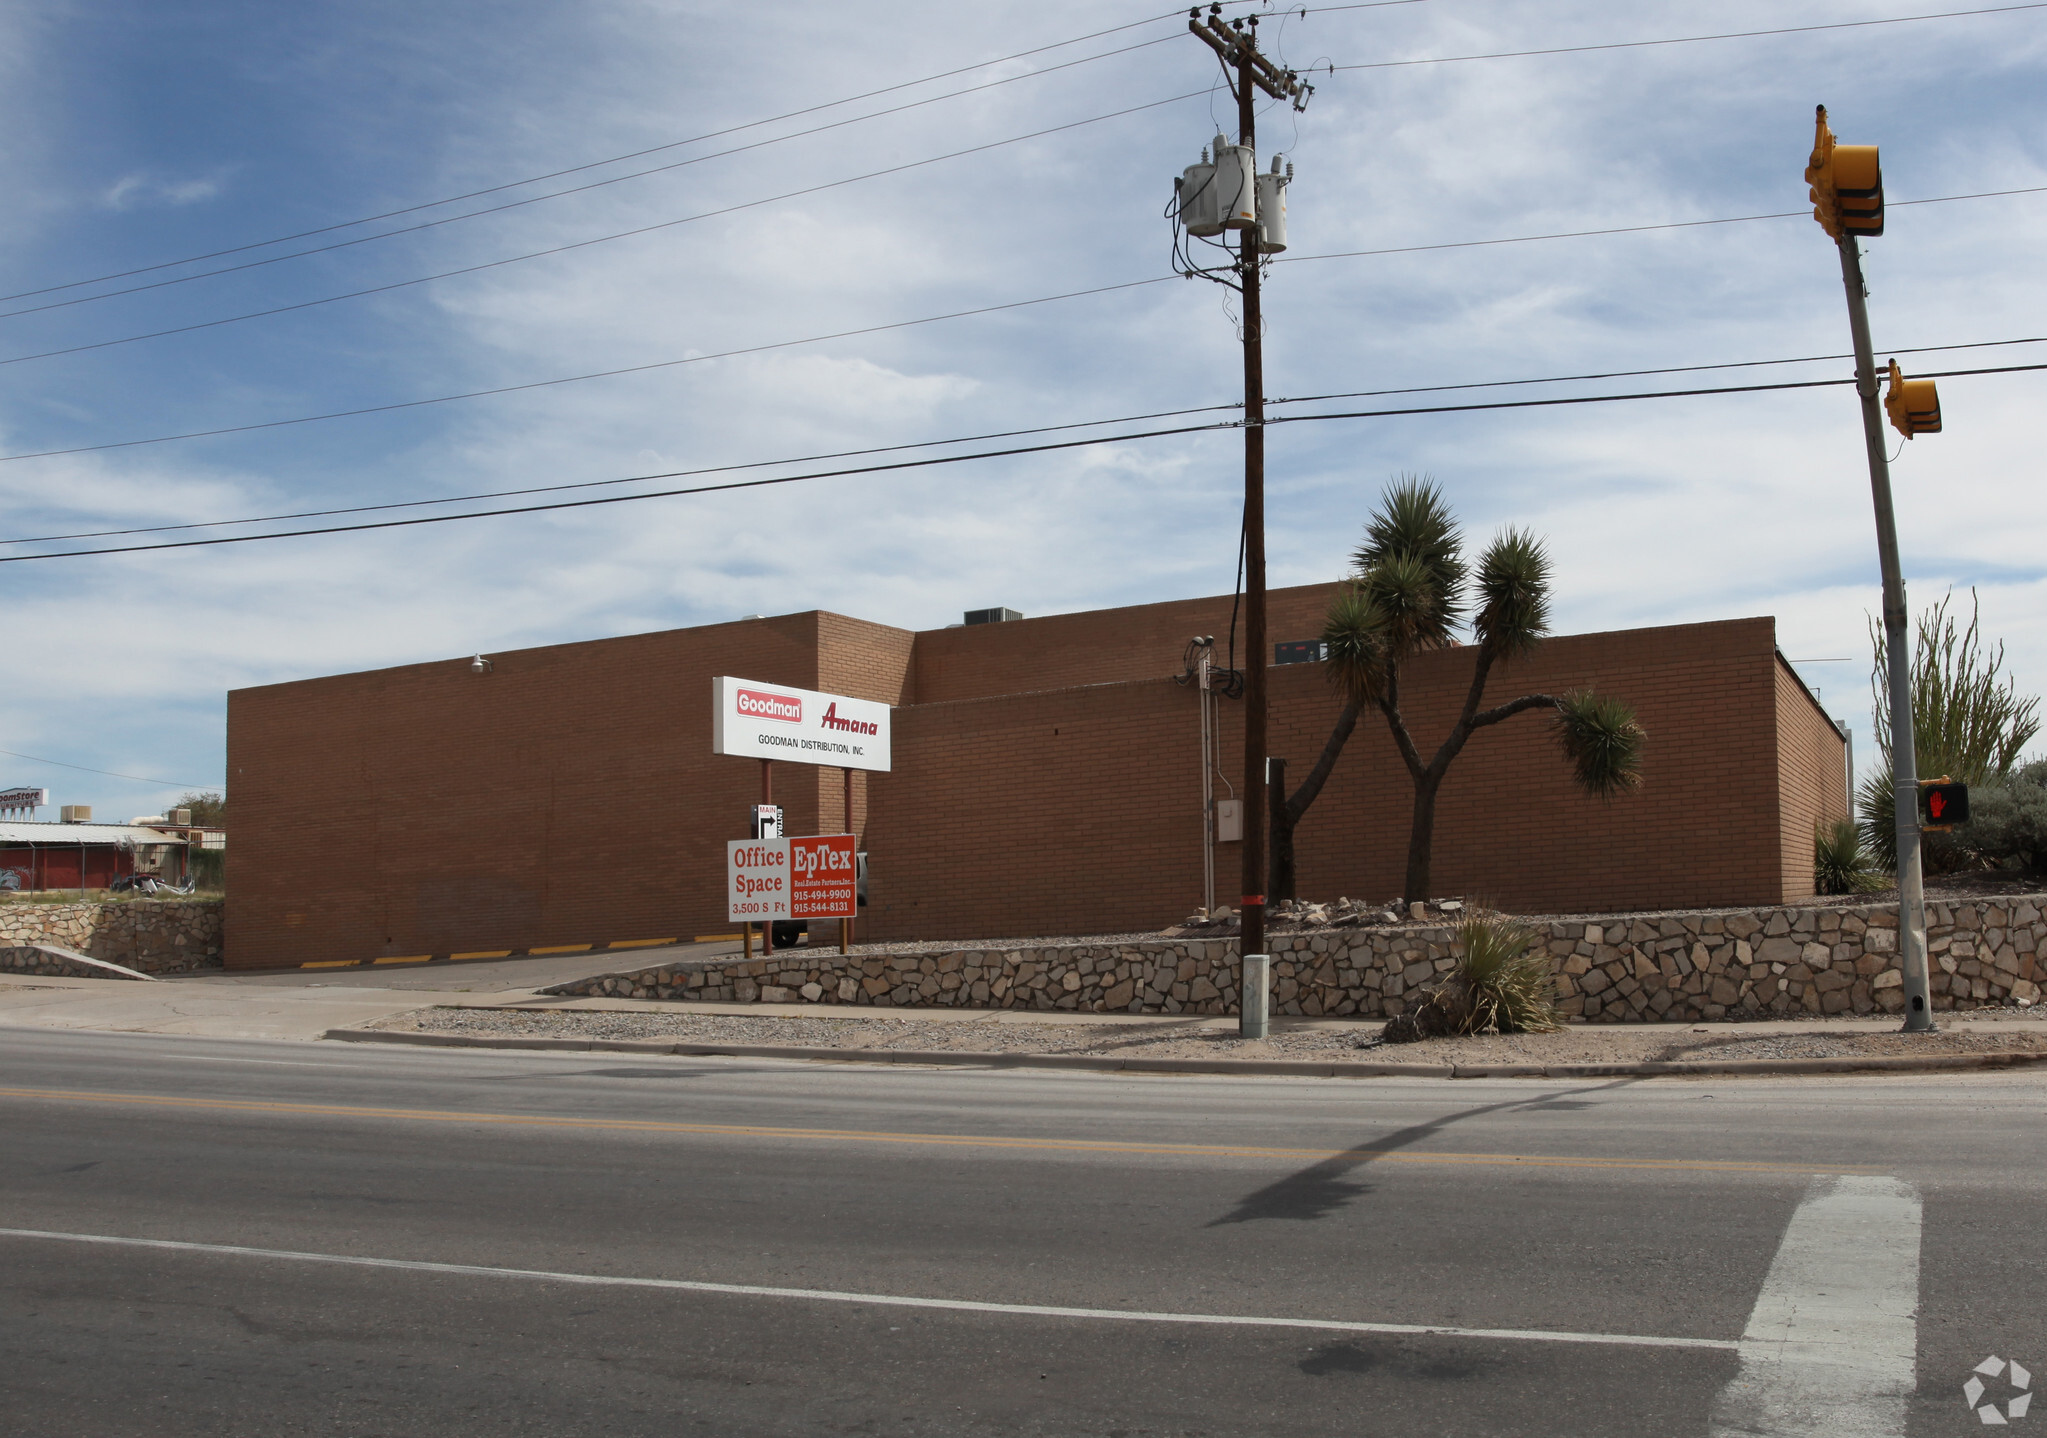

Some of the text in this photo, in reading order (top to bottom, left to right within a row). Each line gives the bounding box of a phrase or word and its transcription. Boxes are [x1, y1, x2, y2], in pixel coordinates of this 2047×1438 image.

[738, 694, 800, 718] Goodman
[821, 702, 878, 736] Amana
[758, 734, 865, 756] GOODMAN DISTRIBUTION, INC.
[734, 846, 784, 868] Office
[793, 844, 851, 879] EpTex
[736, 874, 782, 898] Space
[793, 889, 851, 901] 915-494-9900
[732, 901, 785, 914] 3,500 S Ft
[793, 901, 848, 913] 915-544-8131
